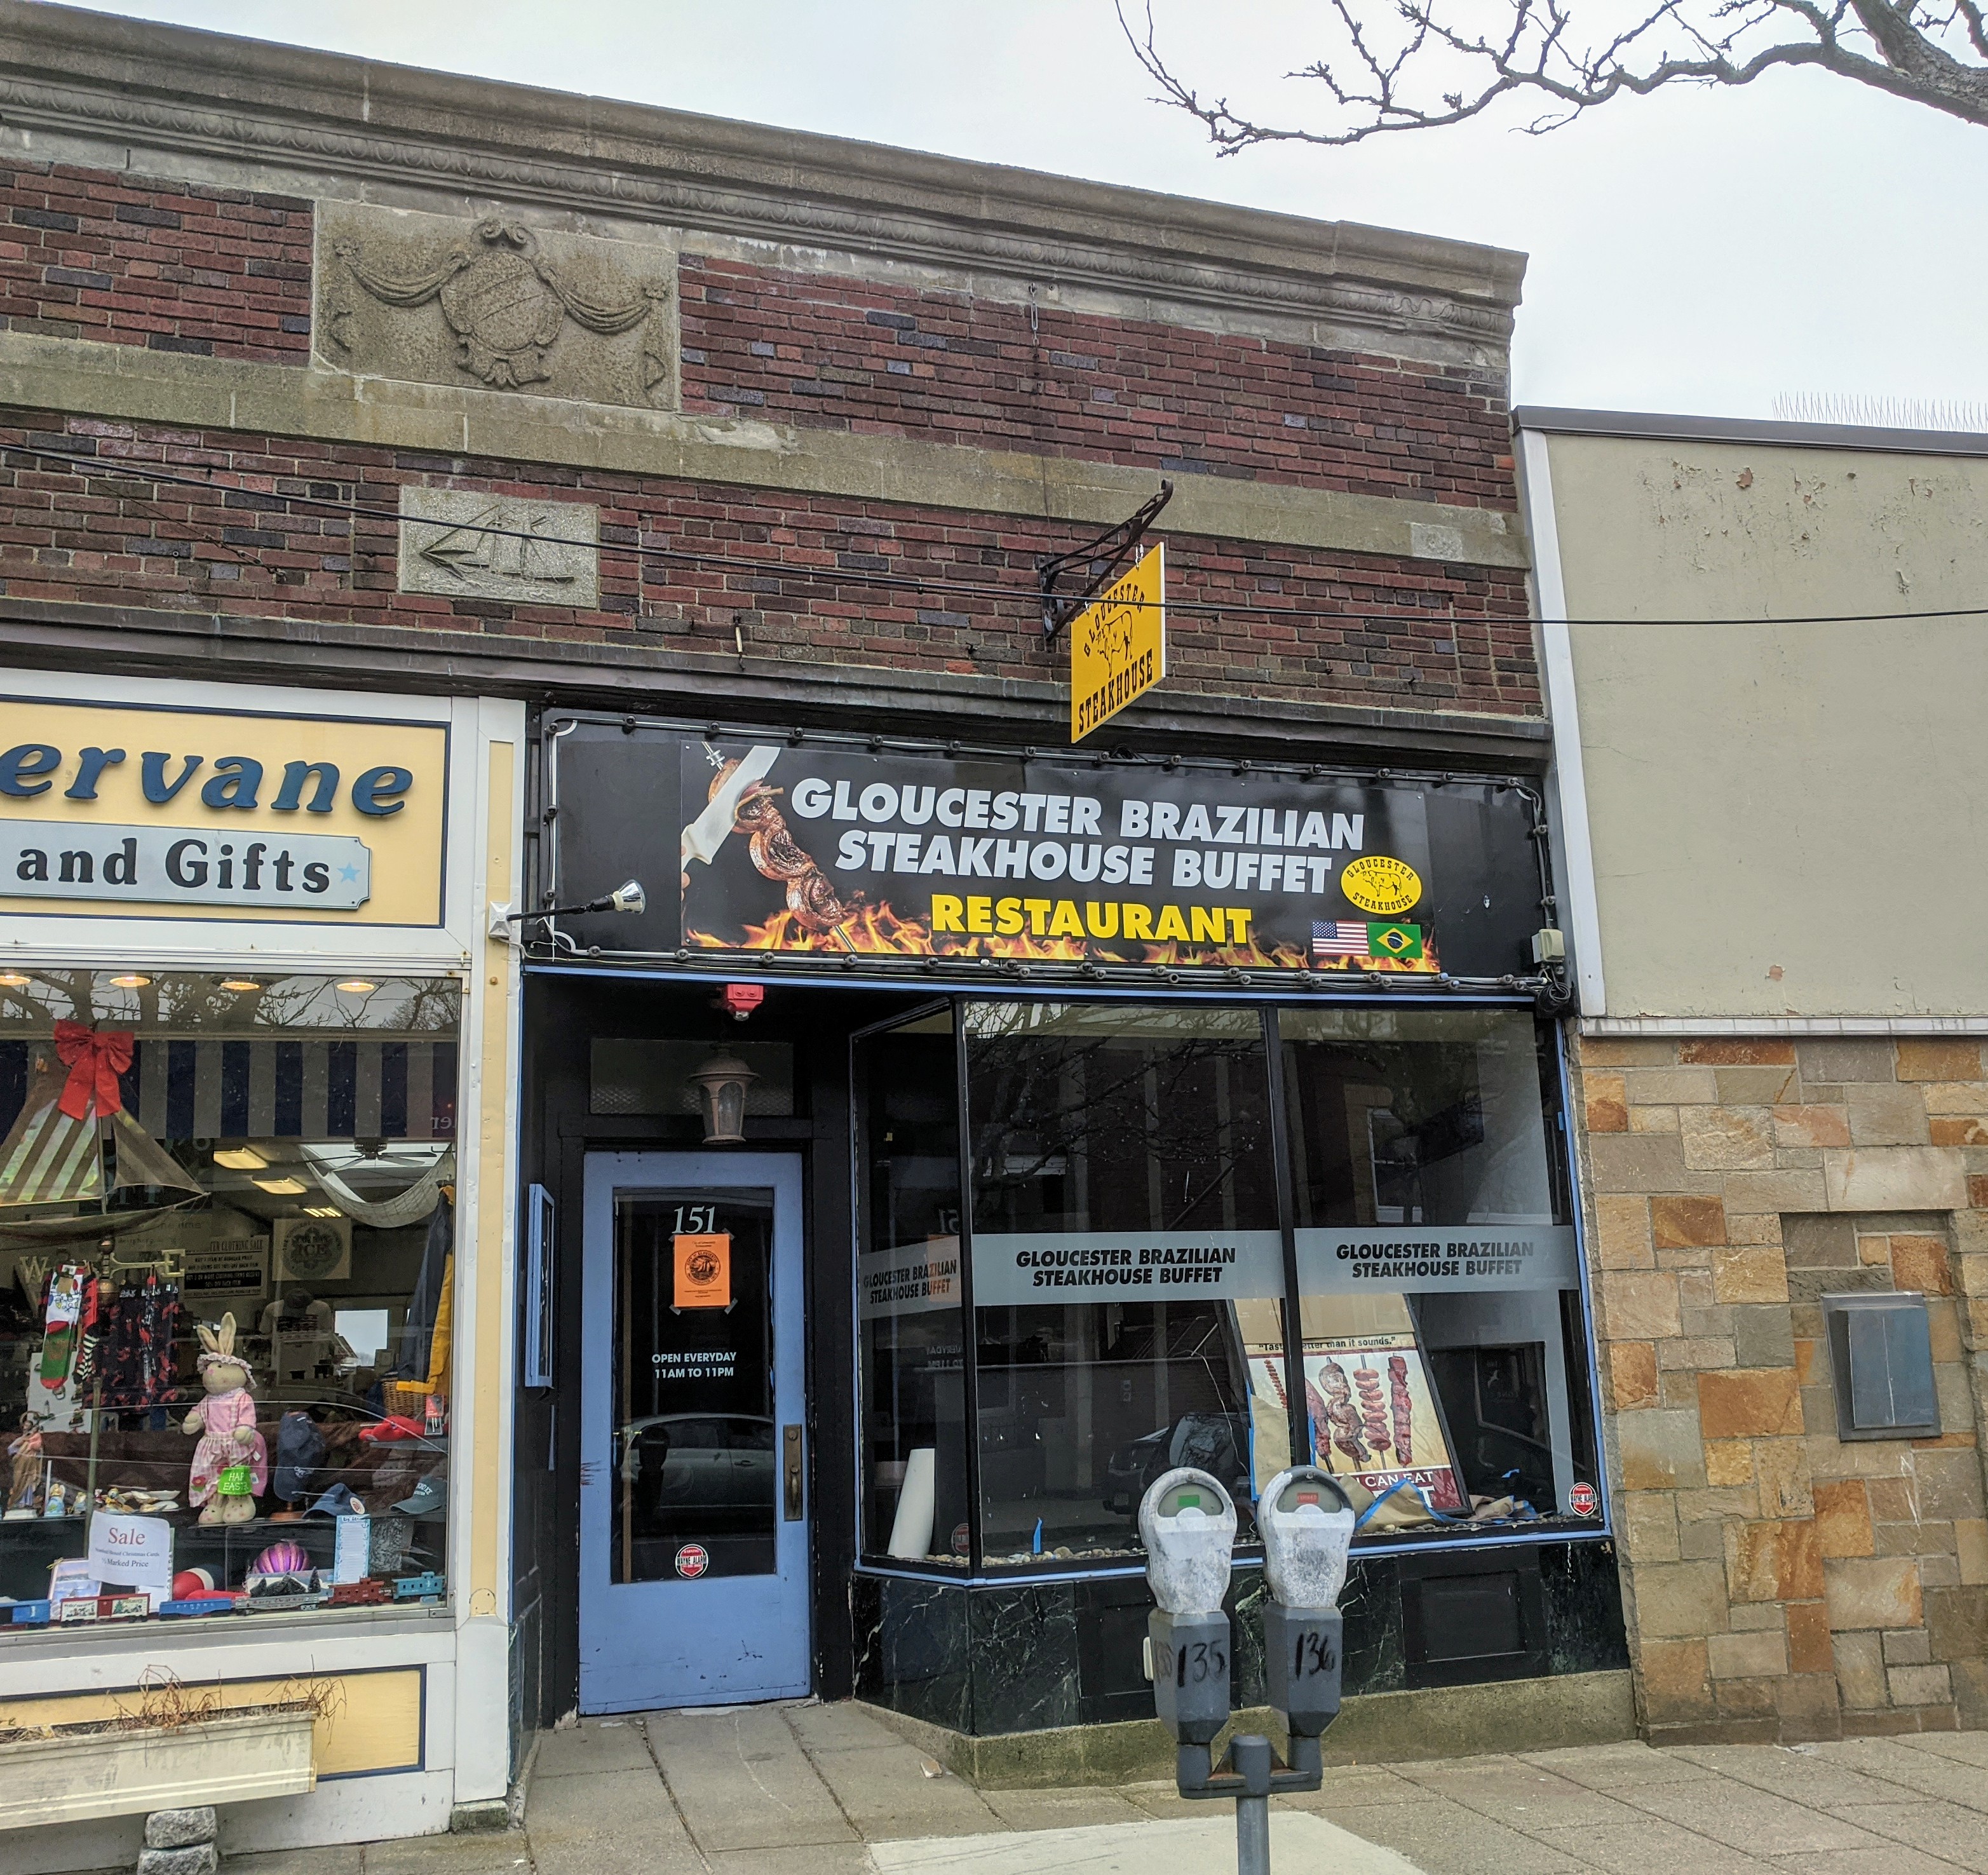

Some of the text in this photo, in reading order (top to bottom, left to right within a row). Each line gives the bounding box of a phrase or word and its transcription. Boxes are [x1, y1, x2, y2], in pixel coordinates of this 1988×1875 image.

[1083, 583, 1146, 657] GLOUCESTER
[1079, 647, 1153, 733] STEAKHOUSE
[0, 743, 413, 815] ervane
[791, 778, 1364, 851] GLOUCESTER BRAZILIAN
[16, 837, 330, 893] and Gifts
[834, 829, 1332, 894] STEAKHOUSE BUFFET
[1346, 858, 1414, 881] GLOUCESTER
[1353, 891, 1412, 910] STEAKHOUSE
[931, 893, 1252, 944] RESTAURANT
[672, 1206, 716, 1234] 151
[1016, 1247, 1236, 1268] GLOUCESTER BRAZILIAN
[1336, 1242, 1534, 1260] GLOUCESTER BRAZILIAN
[863, 1259, 957, 1289] GLOUCESTER BRAZILIAN
[1032, 1267, 1222, 1287] STEAKHOUSE BUFFET
[1352, 1260, 1522, 1278] STEAKHOUSE BUFFET
[869, 1278, 950, 1304] STEAKHOUSE BUFFET
[1349, 1339, 1355, 1347] it
[652, 1351, 736, 1364] OPEN EVERYDAY
[654, 1367, 734, 1379] 11AM TO 11PM
[1365, 1474, 1398, 1487] CAN
[1403, 1471, 1433, 1484] EAT
[108, 1527, 145, 1545] Sale
[107, 1558, 129, 1567] Marked
[677, 1555, 707, 1566] WAYNE ALARM
[1177, 1639, 1227, 1688] 135
[1295, 1632, 1334, 1681] 136
